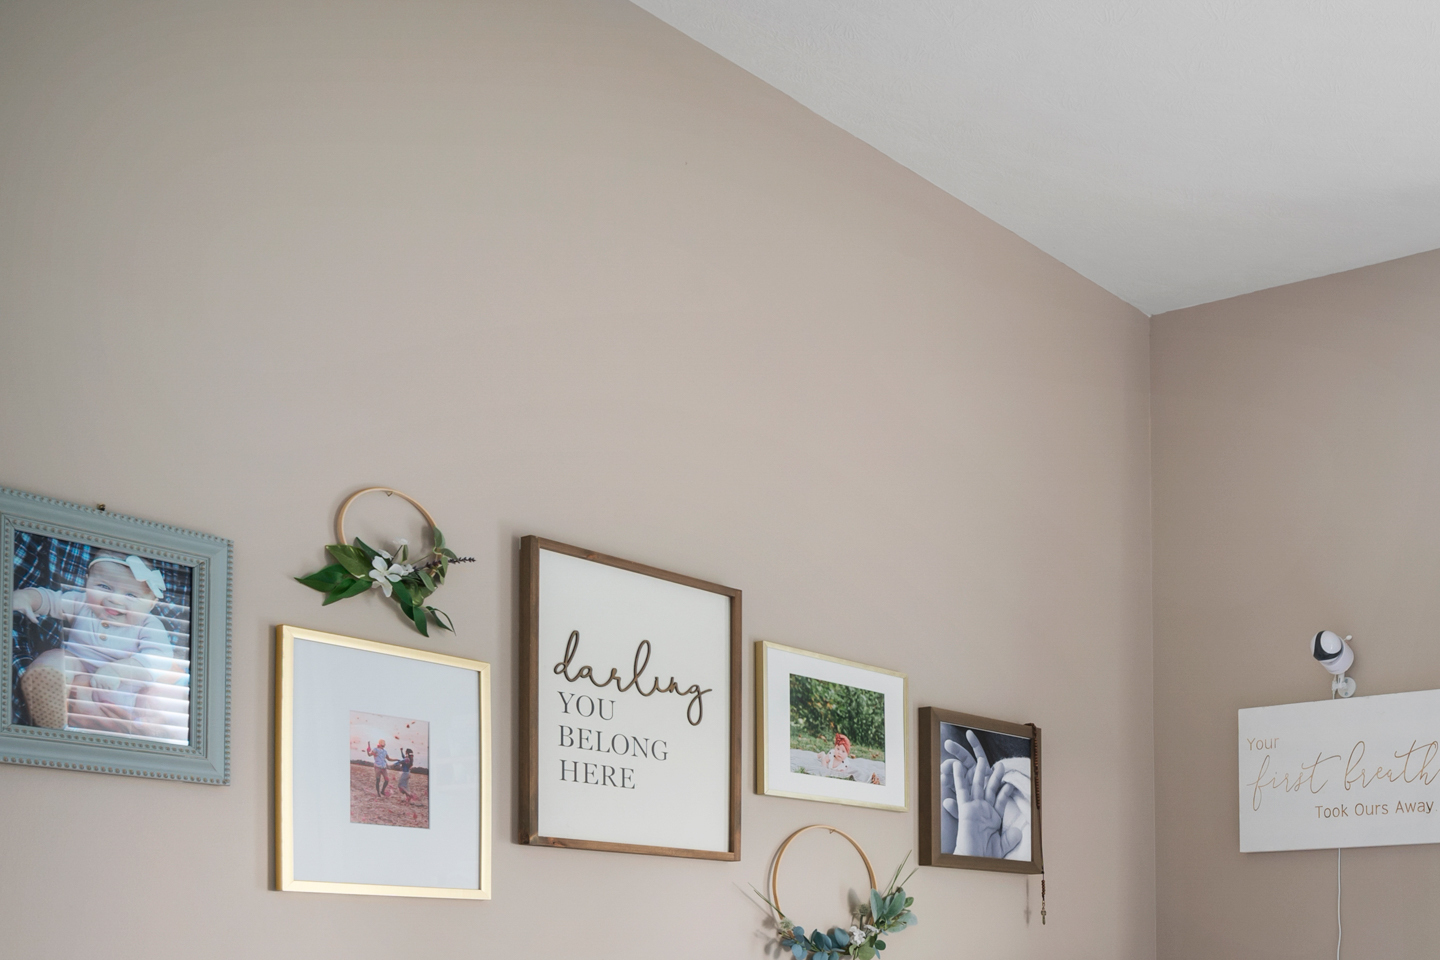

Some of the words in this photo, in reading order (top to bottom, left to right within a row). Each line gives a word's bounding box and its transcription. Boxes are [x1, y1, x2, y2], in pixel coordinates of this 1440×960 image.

[553, 629, 713, 726] darling
[557, 691, 616, 721] YOU
[558, 724, 669, 762] BELONG
[1247, 737, 1280, 751] Your
[559, 759, 637, 790] HERE
[1246, 751, 1342, 812] first
[1315, 804, 1349, 819] Took
[1354, 802, 1389, 817] Ours
